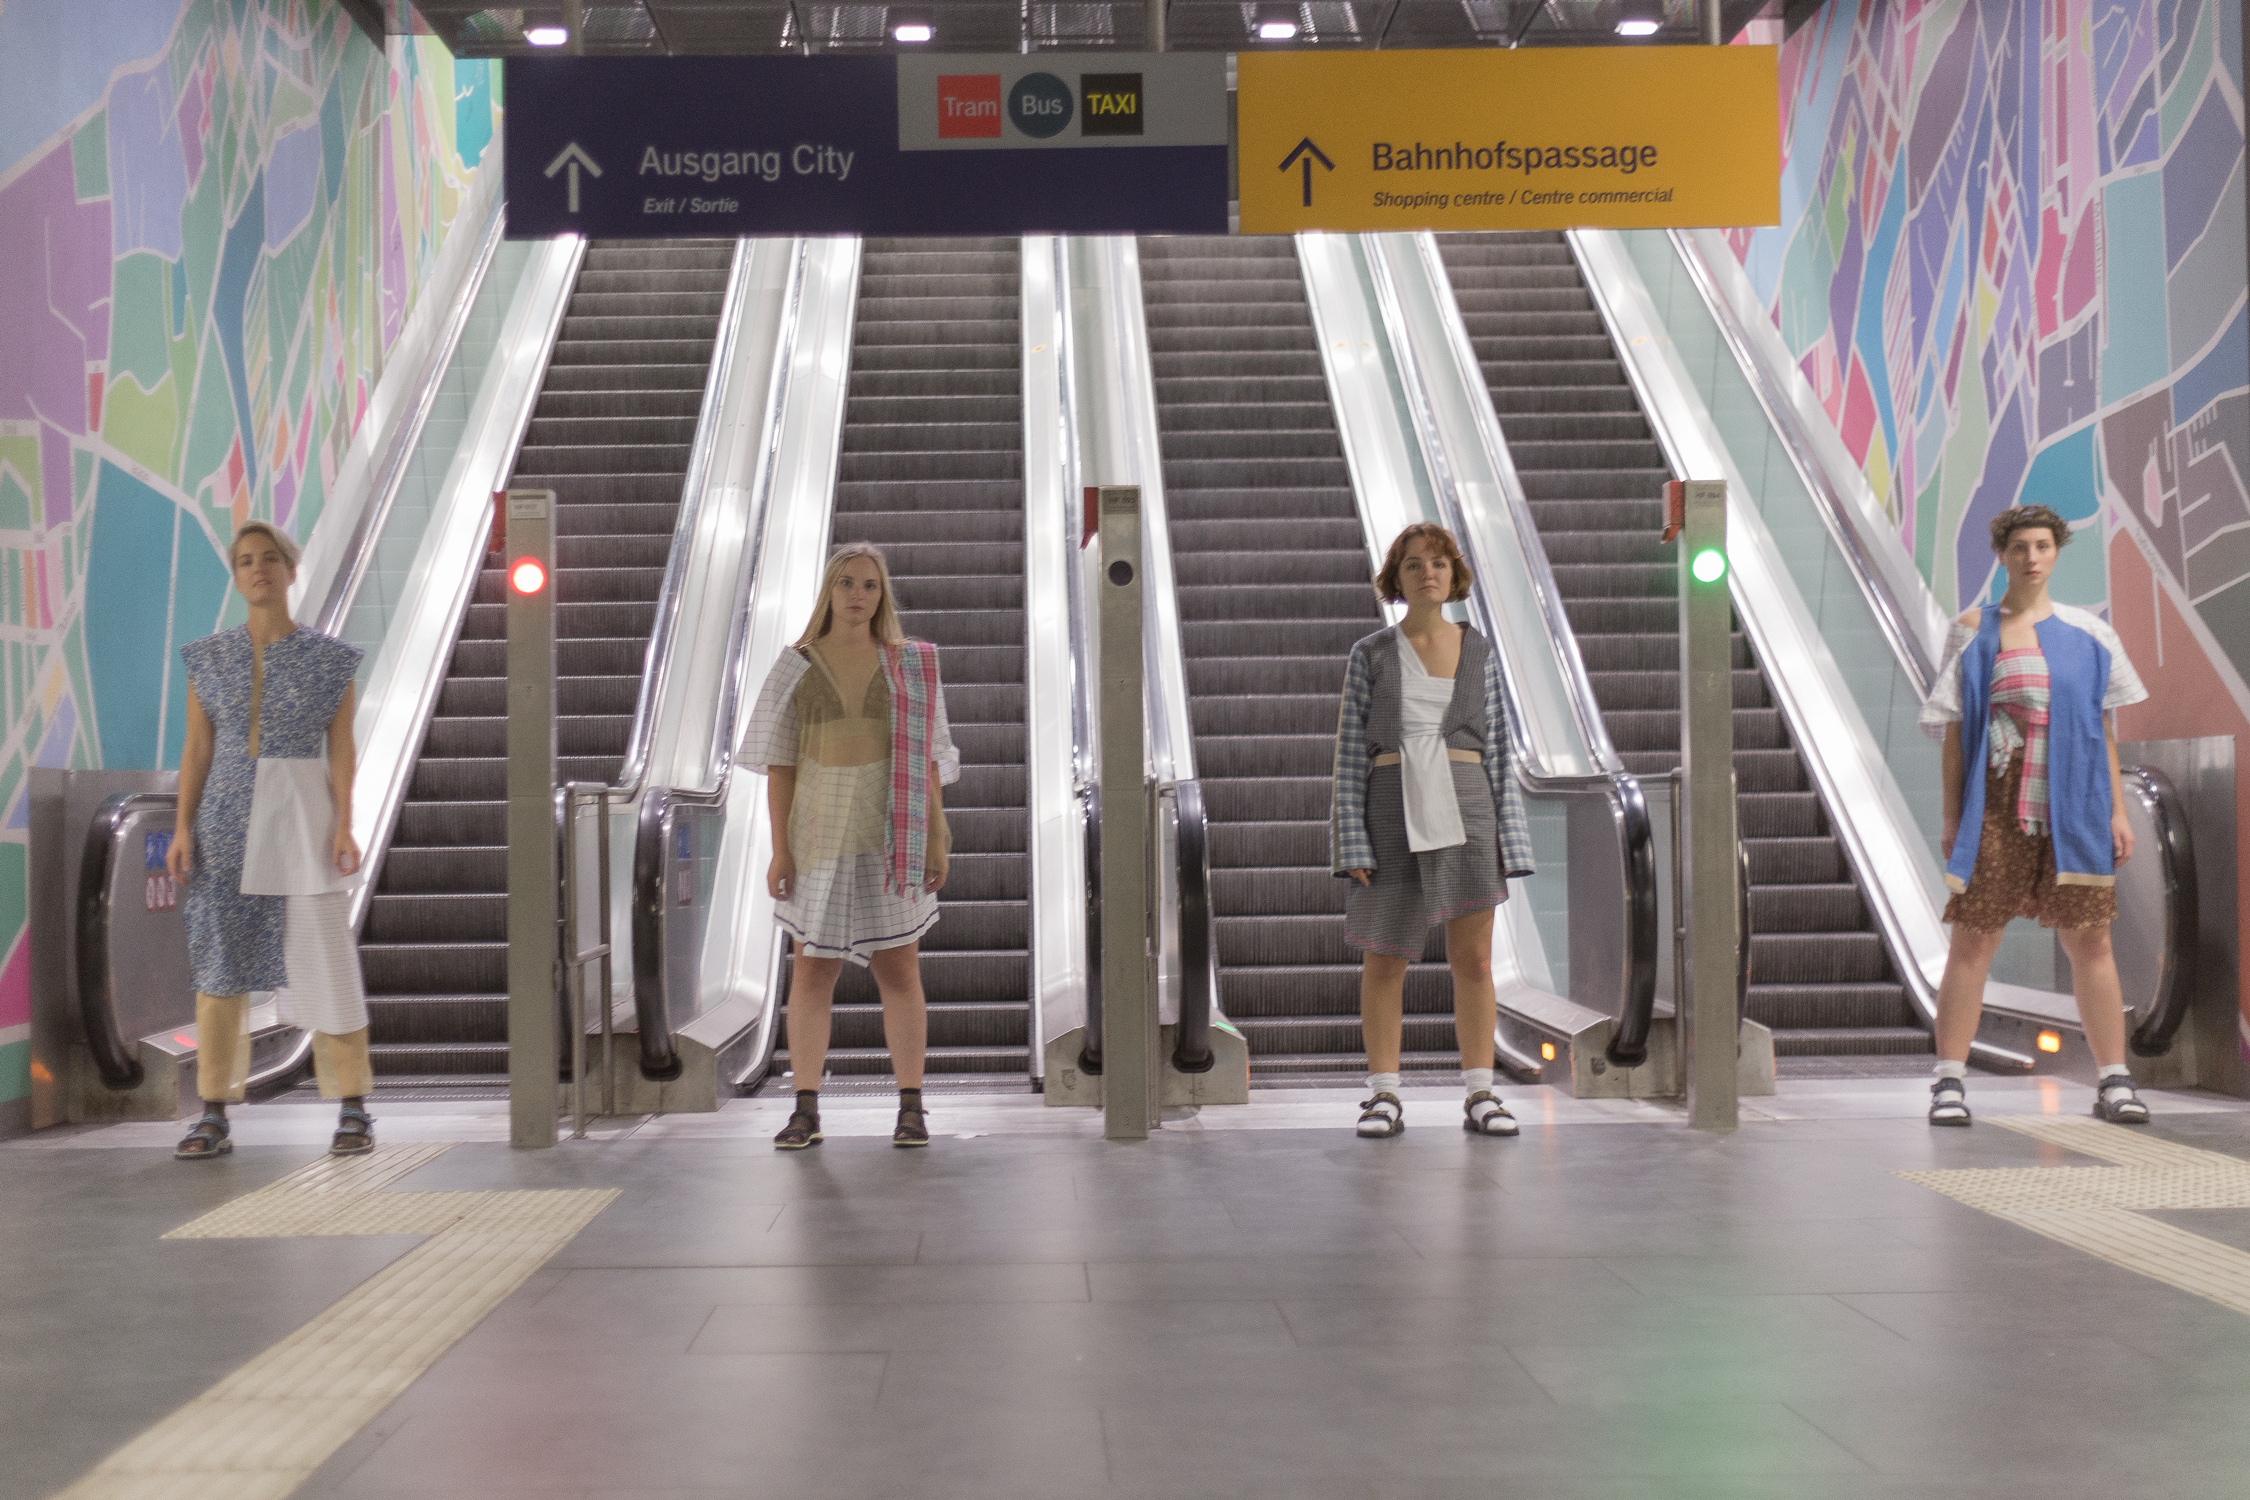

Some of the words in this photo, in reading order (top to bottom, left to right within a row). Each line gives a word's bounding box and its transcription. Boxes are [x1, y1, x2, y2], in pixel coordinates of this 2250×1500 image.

[943, 96, 998, 117] Tram
[1021, 94, 1064, 115] Bus
[1086, 93, 1136, 115] TAXI
[639, 146, 781, 182] Ausgang
[792, 144, 855, 181] City
[1372, 140, 1658, 175] Bahnhofspassage
[643, 197, 676, 213] Exit
[677, 198, 687, 214] /
[690, 196, 739, 213] Sortie
[1373, 190, 1449, 210] Shopping
[1453, 190, 1505, 207] centre
[1509, 189, 1519, 206] /
[1520, 188, 1575, 206] Centre
[1578, 186, 1674, 205] commercial
